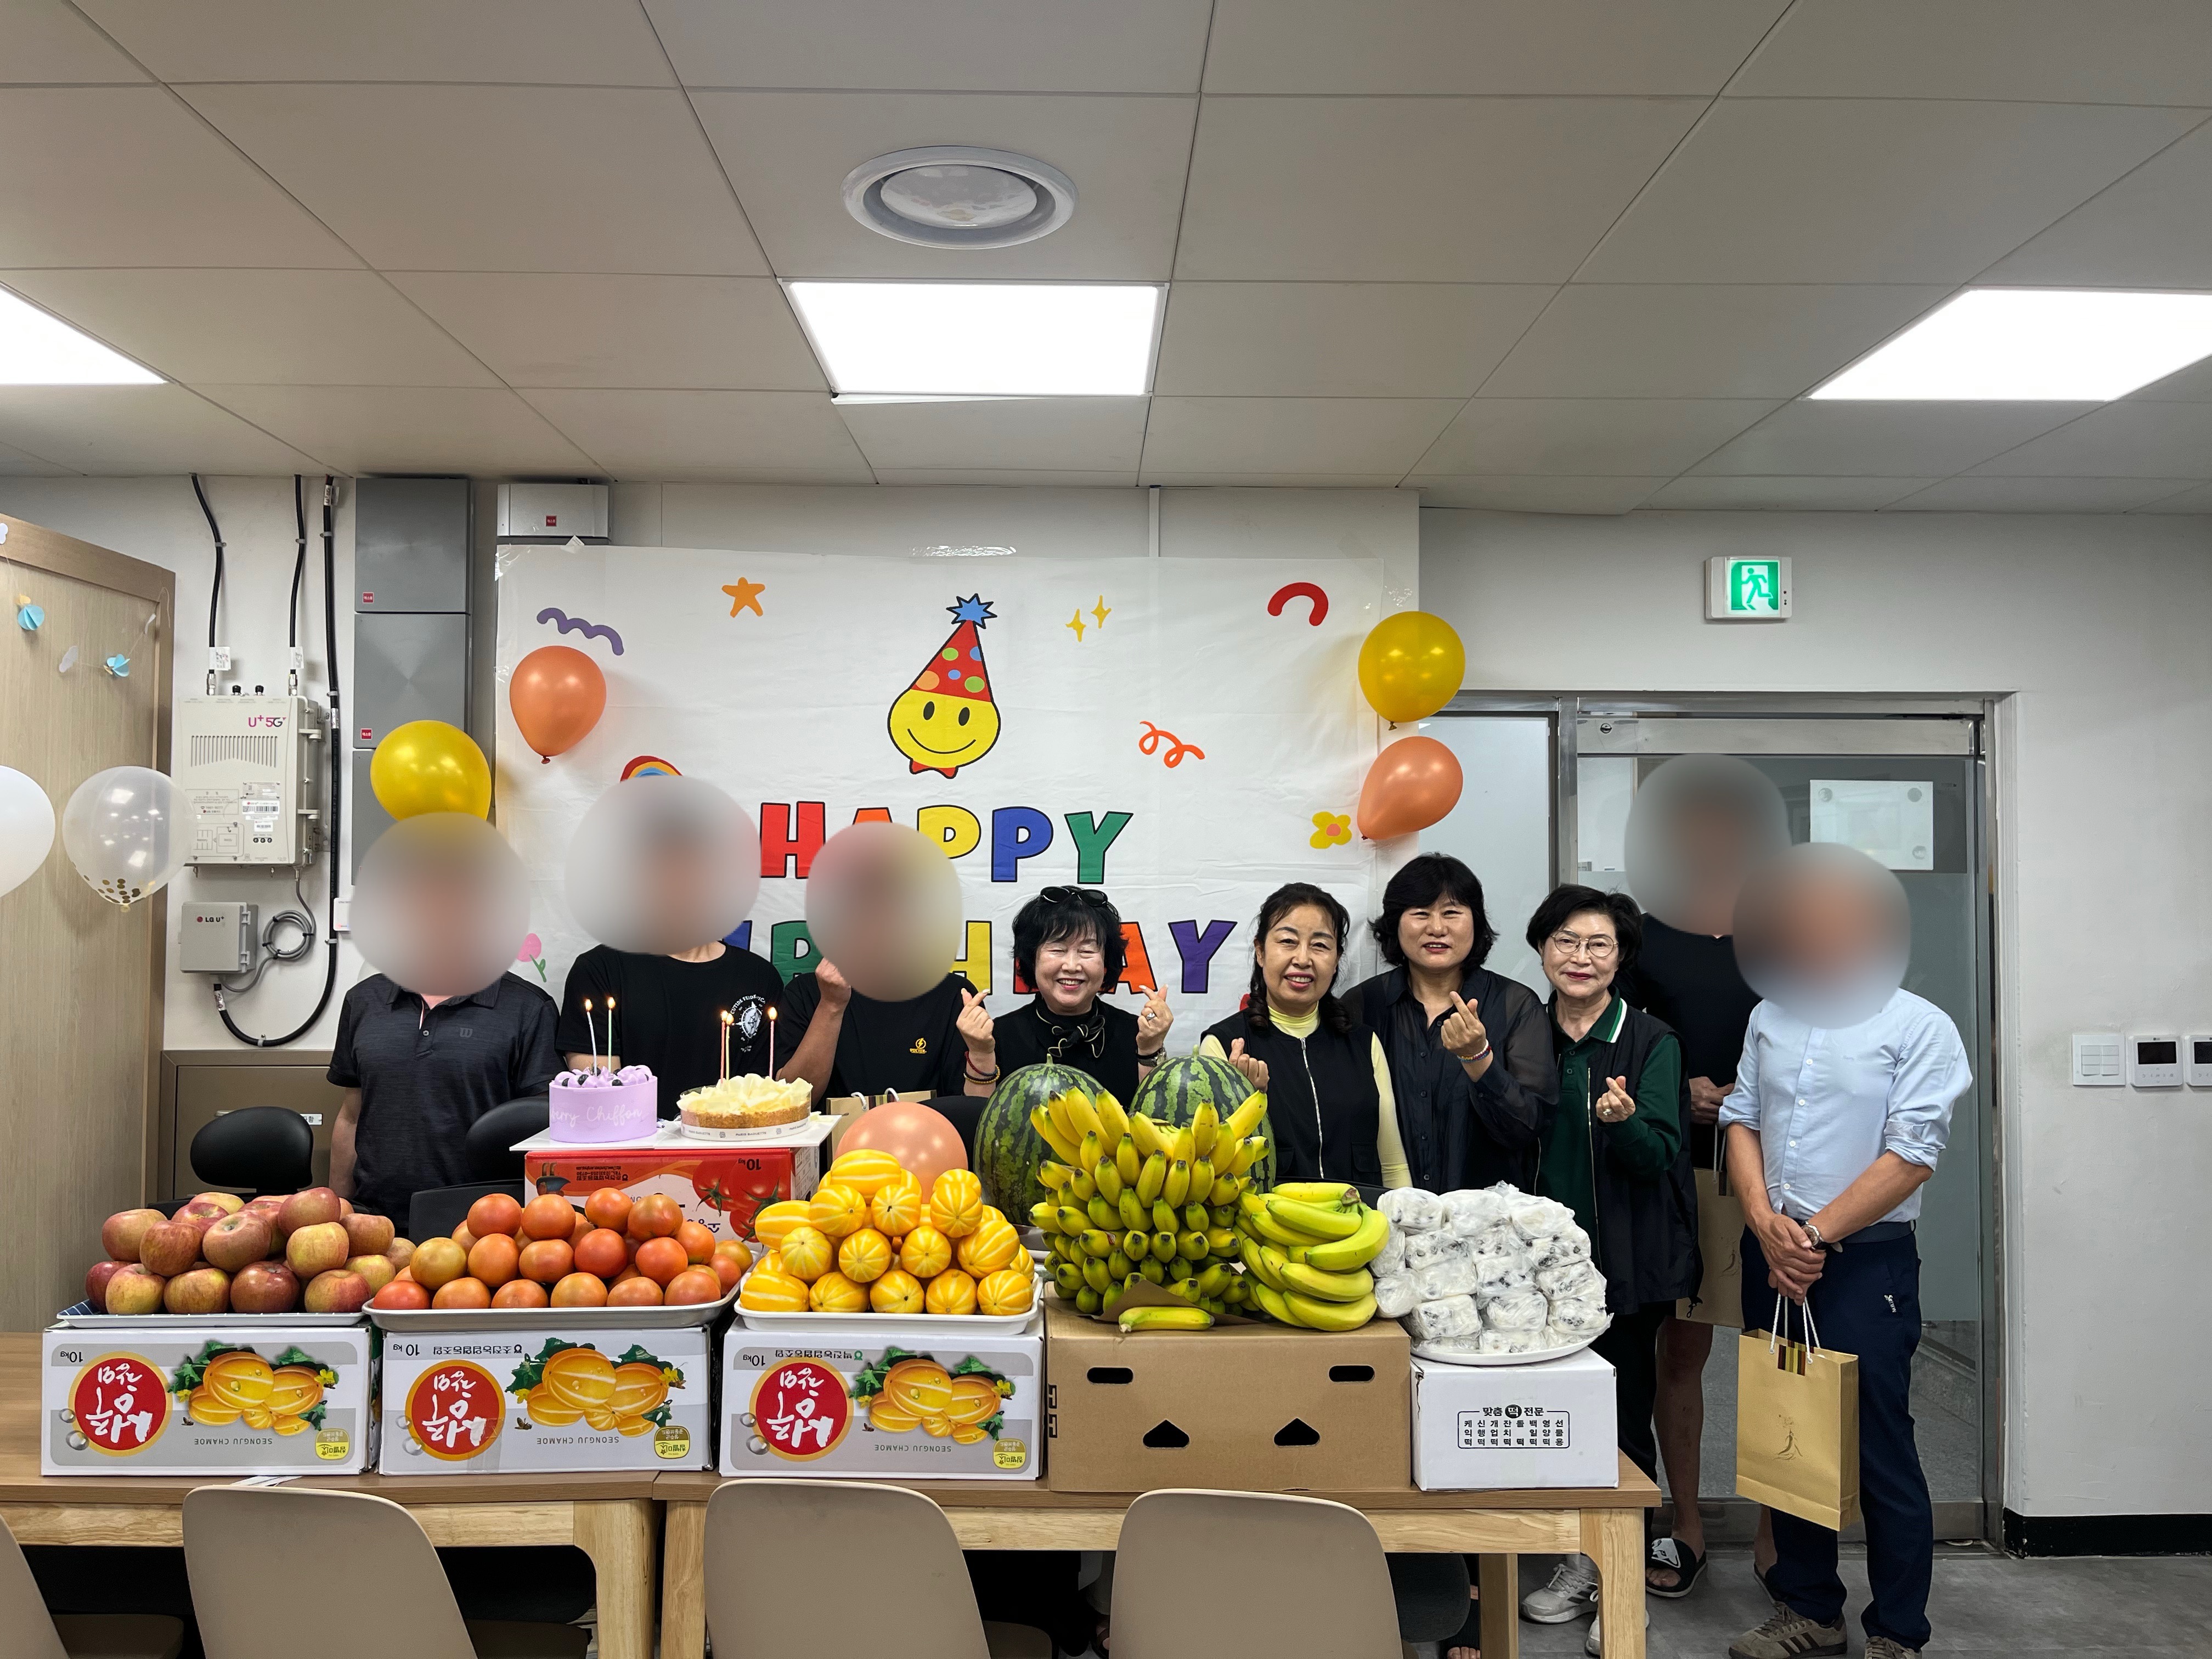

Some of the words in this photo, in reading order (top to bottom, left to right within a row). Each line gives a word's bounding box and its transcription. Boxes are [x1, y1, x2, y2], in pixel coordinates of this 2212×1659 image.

[248, 715, 264, 727] U+
[760, 800, 1133, 884] HPPY
[586, 1103, 642, 1126] Chiffon
[738, 1158, 762, 1171] 10kg
[60, 1351, 83, 1363] 10kg
[405, 1344, 420, 1356] 10
[433, 1346, 512, 1355] 초전농업협동조합
[743, 1355, 766, 1366] 10kg
[97, 1363, 143, 1392] 참외
[433, 1370, 477, 1398] 참외
[780, 1367, 825, 1397] 참외
[85, 1387, 153, 1443] 성주
[422, 1393, 487, 1447] 성주
[766, 1391, 835, 1448] 성주
[1482, 1407, 1503, 1416] 맞춤
[1508, 1407, 1519, 1417] 떡
[1523, 1407, 1544, 1416] 전문
